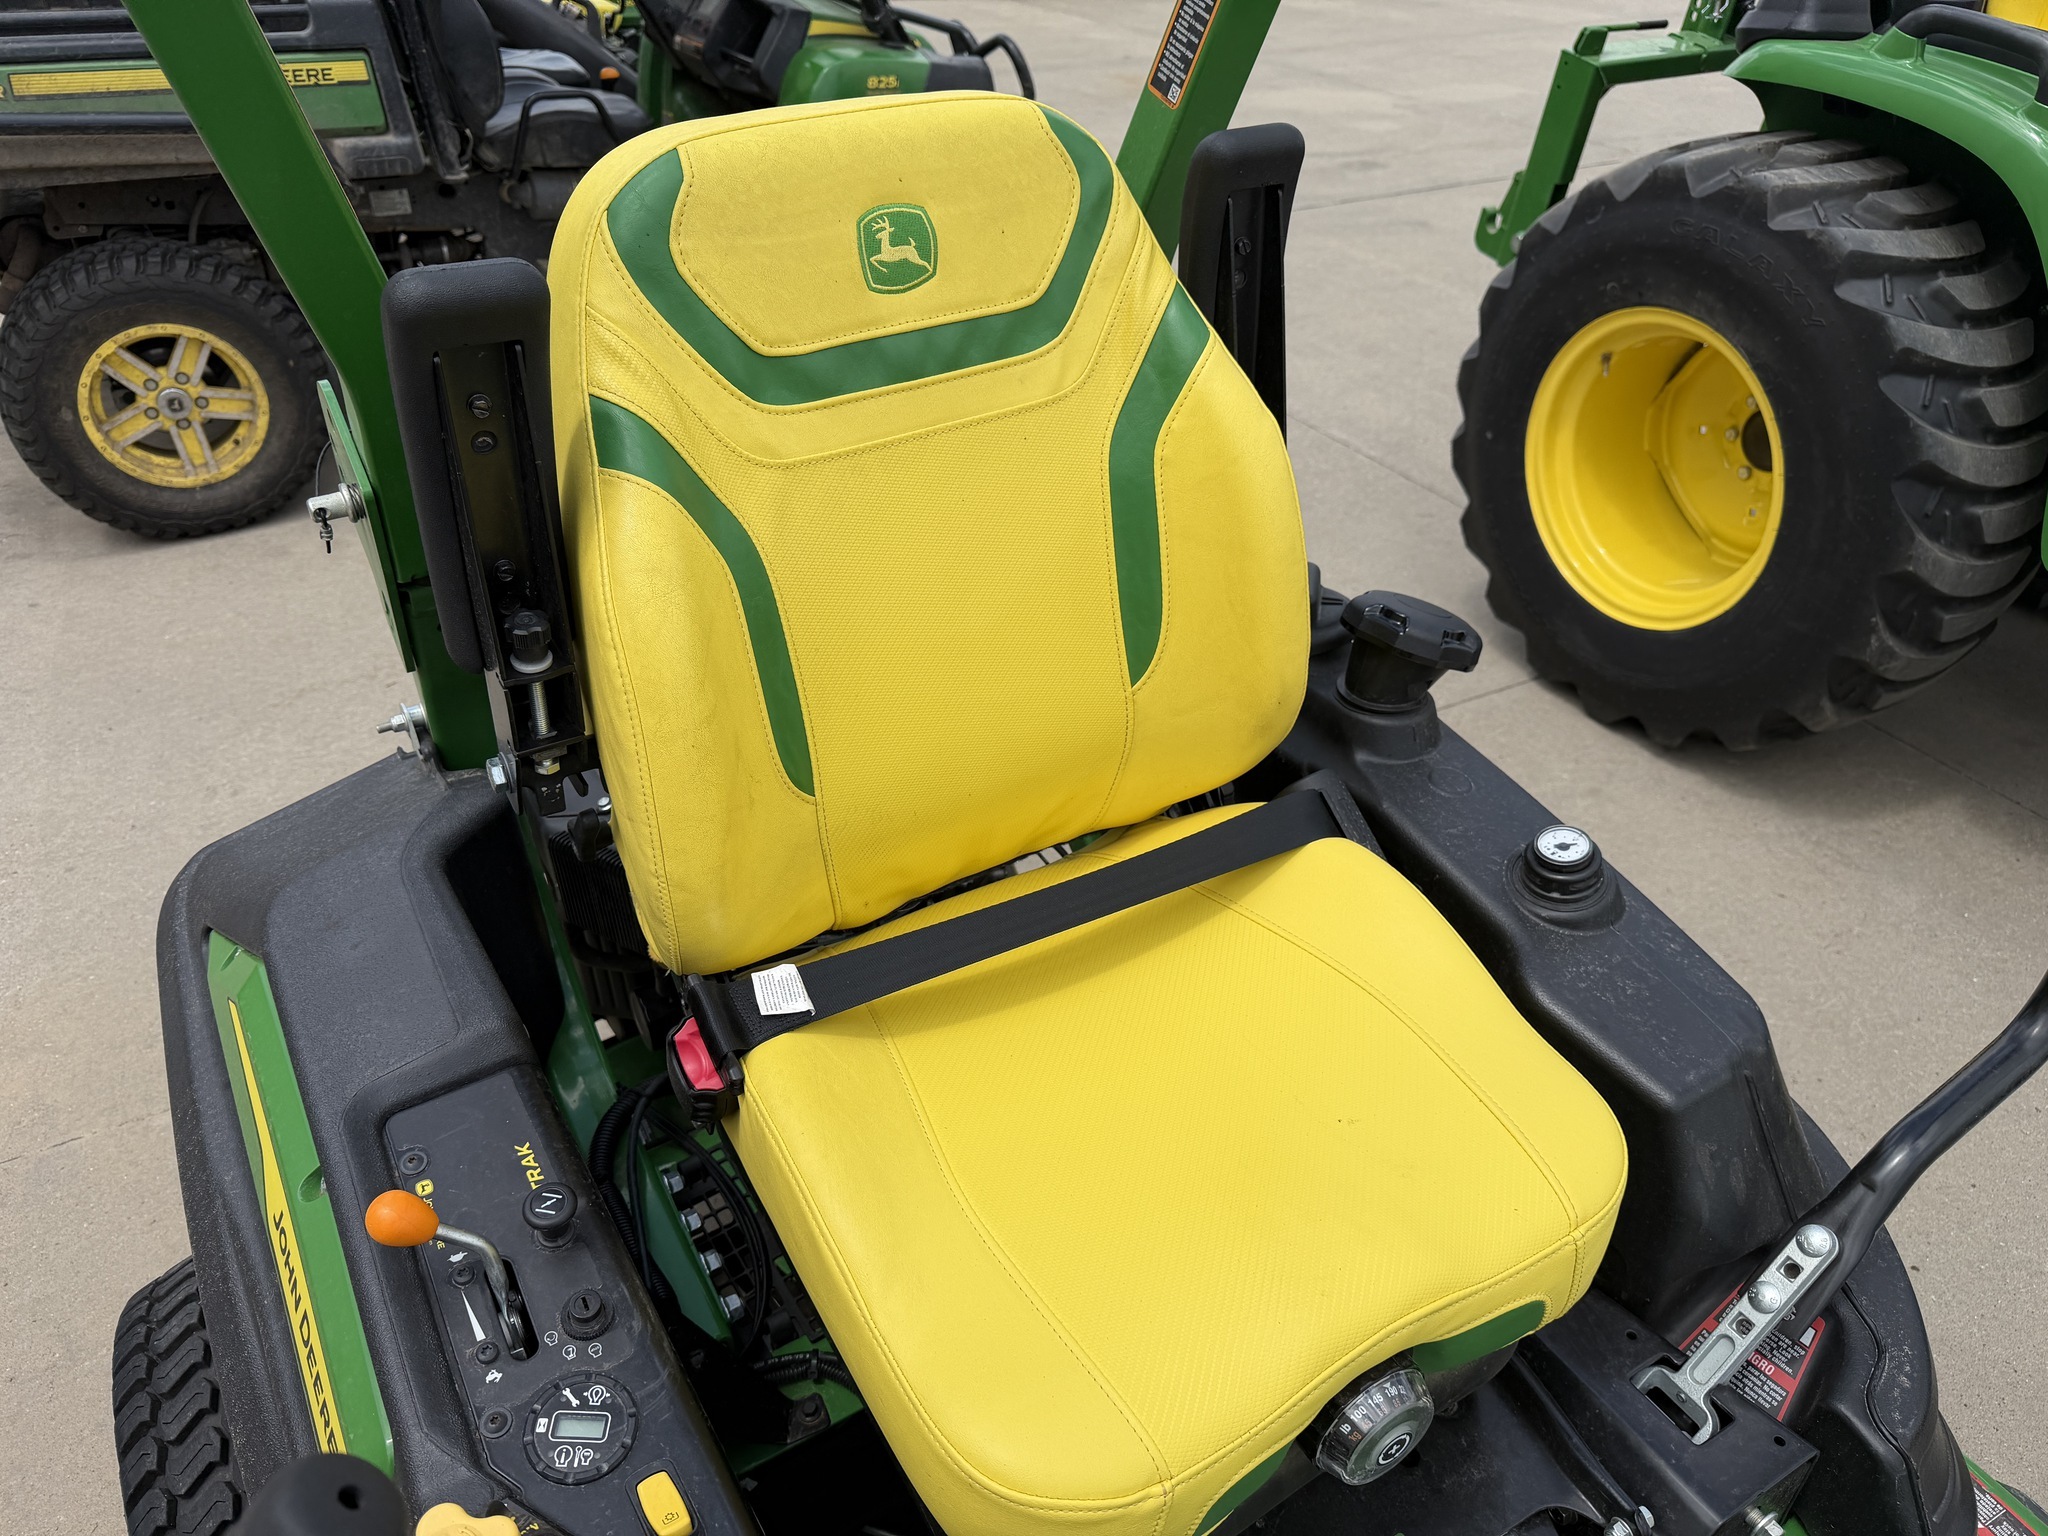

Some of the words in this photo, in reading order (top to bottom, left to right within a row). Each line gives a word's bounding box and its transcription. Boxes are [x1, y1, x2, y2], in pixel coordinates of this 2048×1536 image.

[1670, 217, 1826, 326] GALAXY
[273, 1210, 302, 1308] JOHN
[299, 1309, 338, 1454] DEERE
[1367, 1392, 1384, 1408] 145
[1350, 1405, 1367, 1422] 100
[1339, 1423, 1352, 1435] lb
[1348, 1430, 1362, 1442] kg
